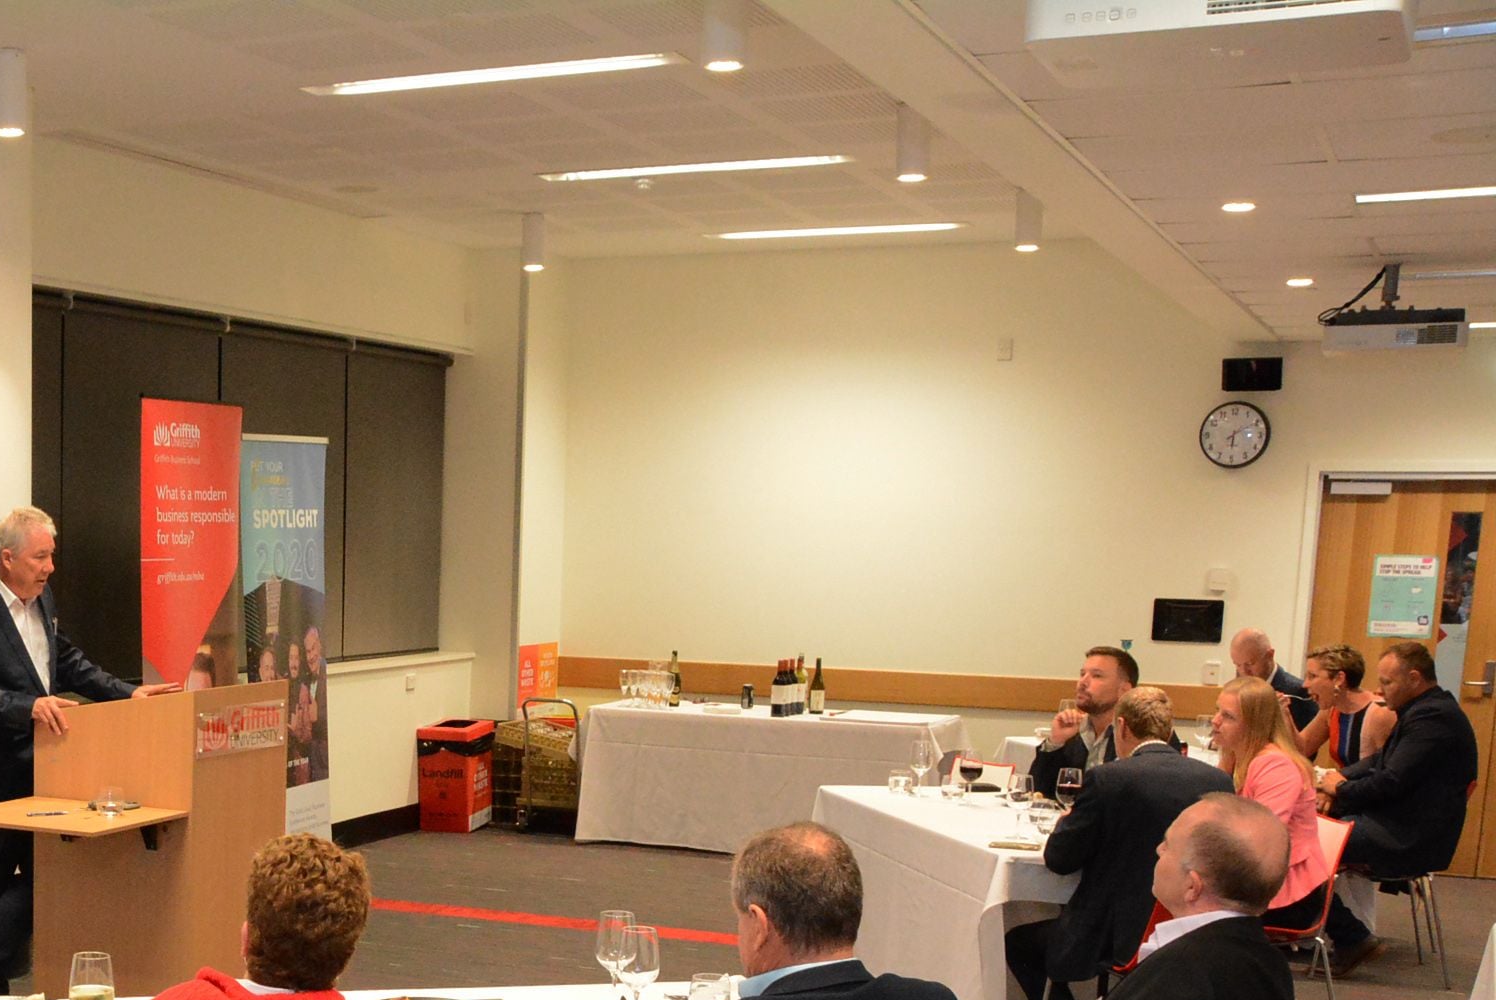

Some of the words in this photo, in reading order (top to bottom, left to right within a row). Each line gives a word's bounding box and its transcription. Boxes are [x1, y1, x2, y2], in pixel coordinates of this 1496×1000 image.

[170, 422, 200, 439] Griffith
[156, 484, 178, 500] What
[180, 486, 185, 500] is
[187, 490, 192, 500] a
[194, 485, 227, 501] modern
[156, 507, 189, 522] business
[190, 508, 235, 526] responsible
[252, 509, 318, 528] SPOTLIGHT
[157, 529, 169, 544] for
[172, 530, 194, 547] today?
[256, 538, 317, 582] 2020
[230, 706, 280, 732] Griffith
[229, 729, 279, 748] UNIVERSITY
[422, 768, 464, 779] Landfill
